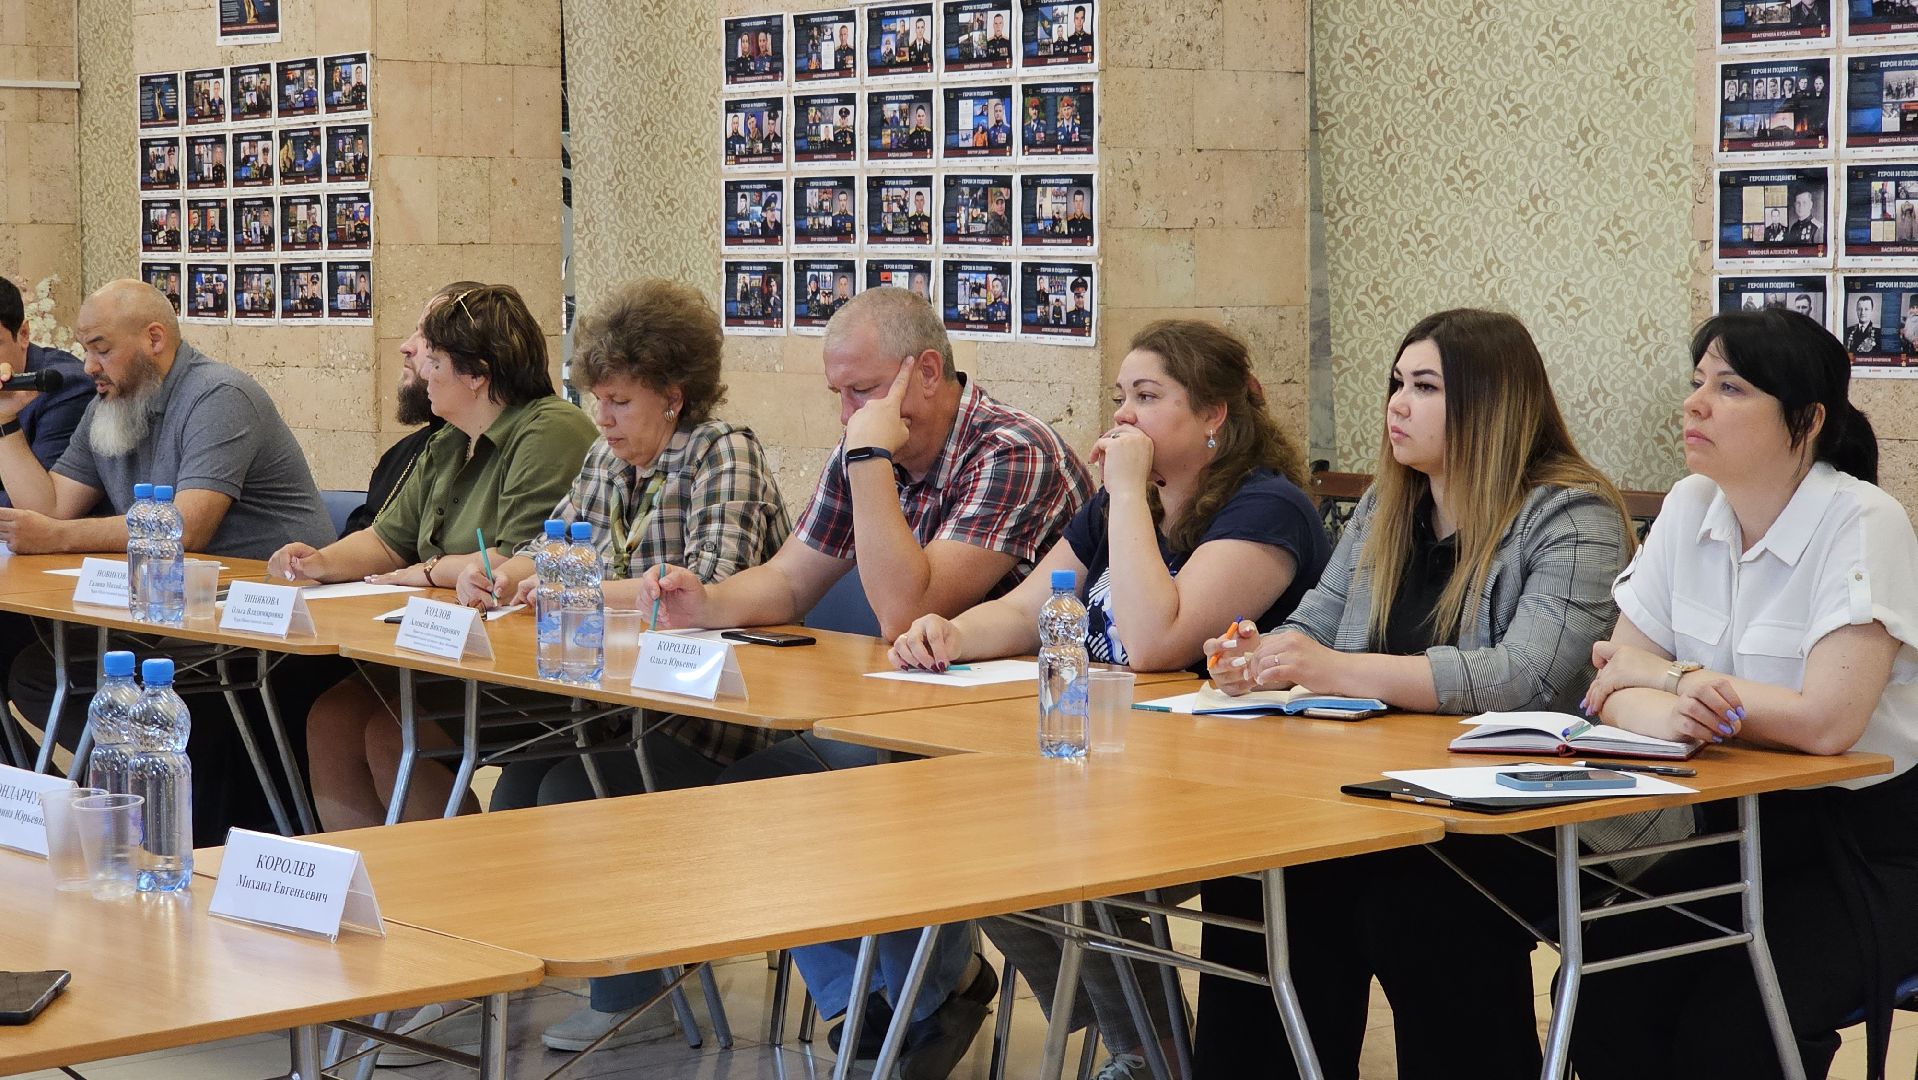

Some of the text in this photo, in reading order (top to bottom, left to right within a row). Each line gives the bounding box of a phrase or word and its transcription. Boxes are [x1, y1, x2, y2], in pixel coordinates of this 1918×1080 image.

[96, 569, 128, 580] НОВИКОВ
[424, 606, 452, 620] КОЗЛОВ
[657, 640, 702, 656] КОРОЛЕВА
[649, 655, 697, 669] Ольга Юрьевна
[256, 854, 316, 878] КОРОЛЕВ
[236, 874, 328, 903] Михаил Евгеньевич
